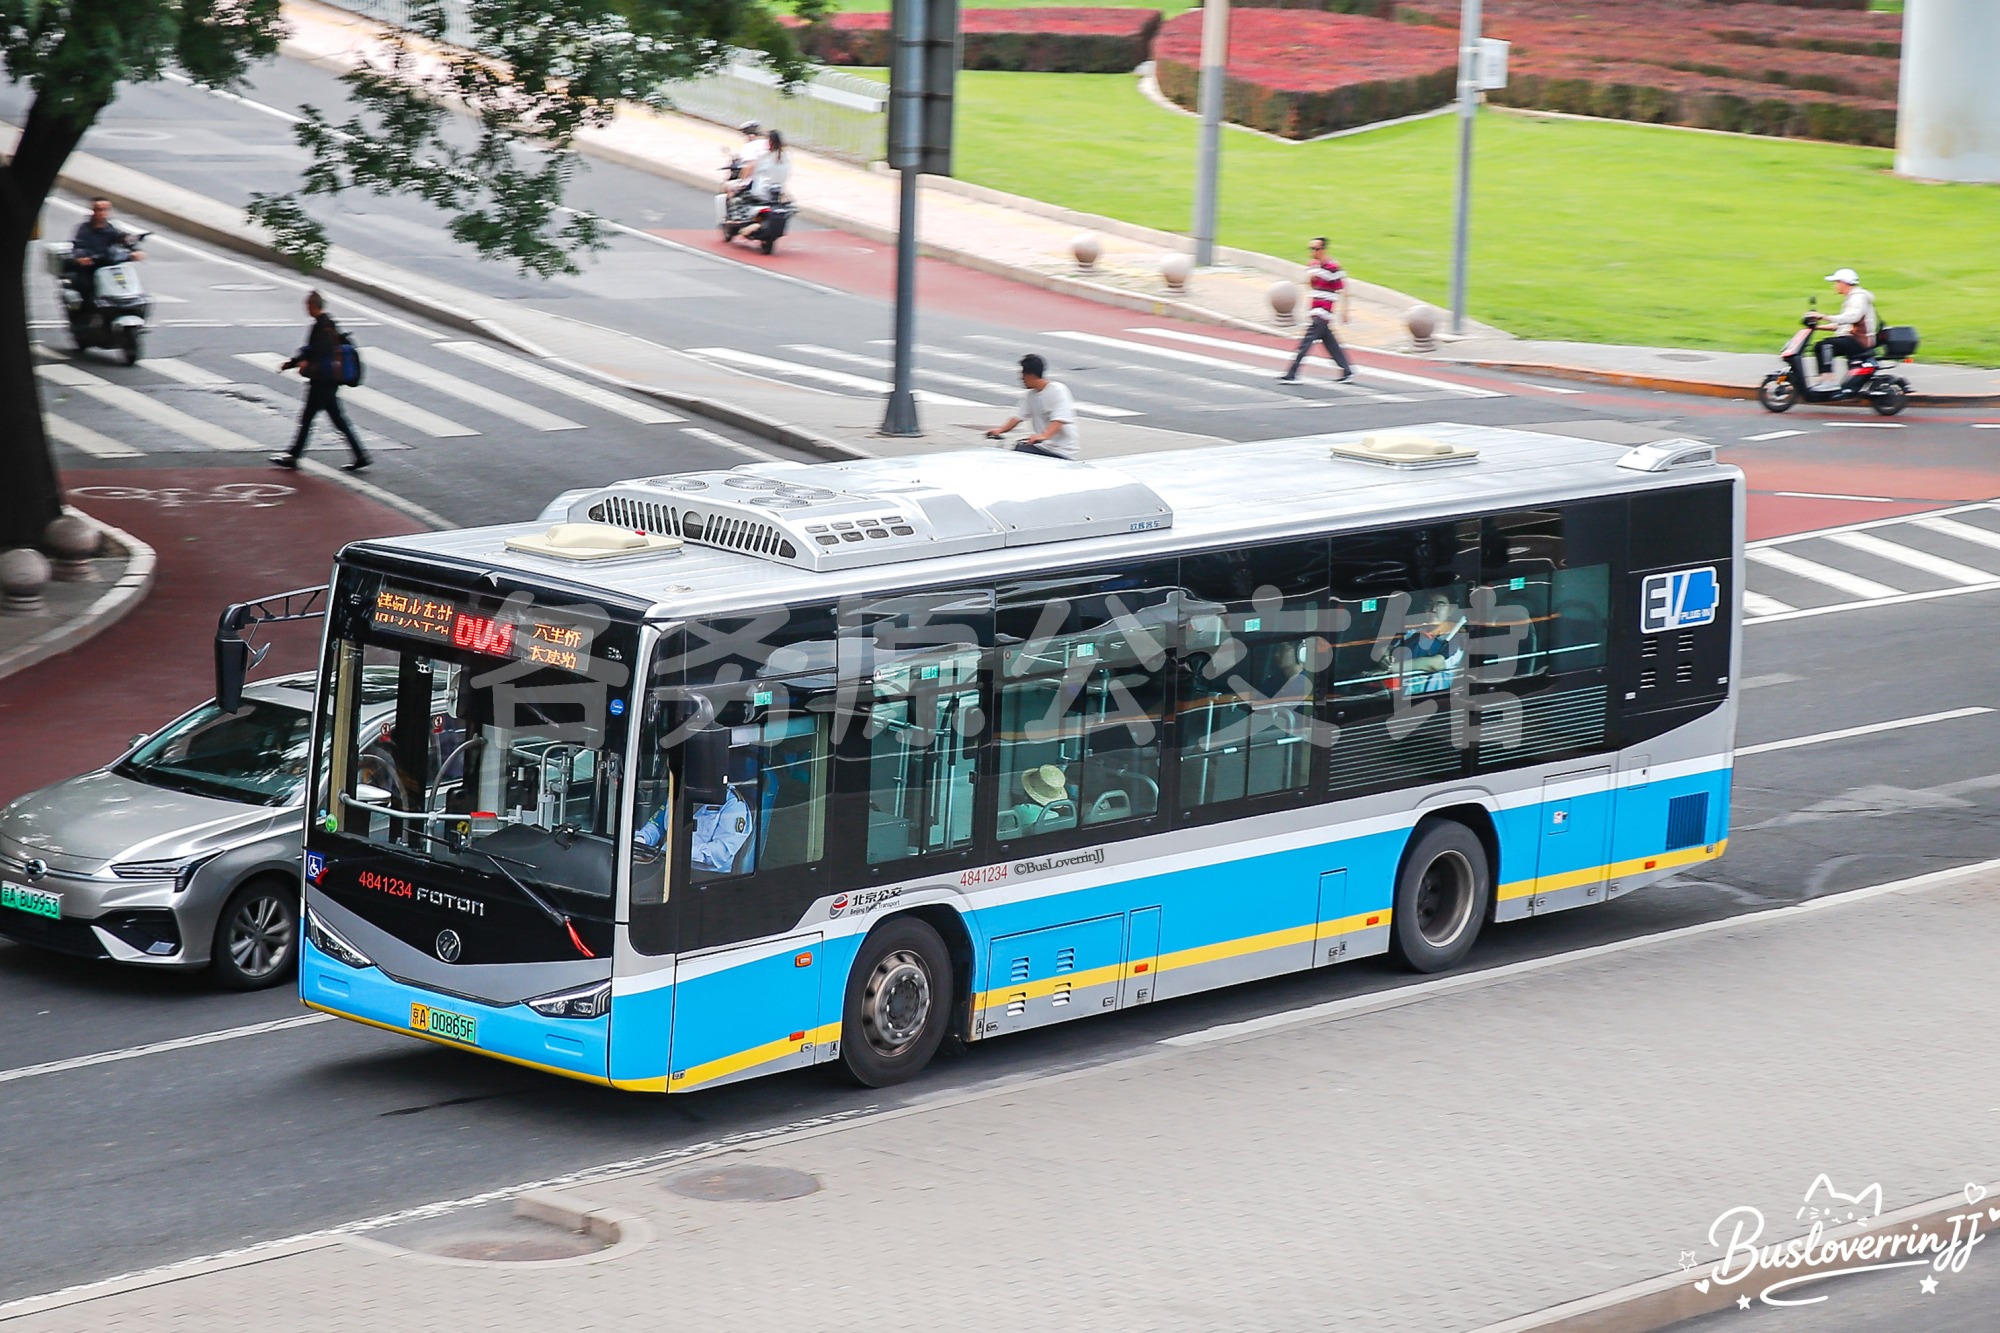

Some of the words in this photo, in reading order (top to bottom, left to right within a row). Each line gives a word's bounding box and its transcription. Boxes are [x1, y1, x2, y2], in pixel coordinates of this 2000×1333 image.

[358, 871, 412, 899] 4841234
[960, 864, 1008, 887] 4841234
[416, 887, 484, 917] FOTON
[850, 905, 866, 915] Beijing
[878, 899, 900, 909] Transport
[852, 886, 903, 907] 北京公交
